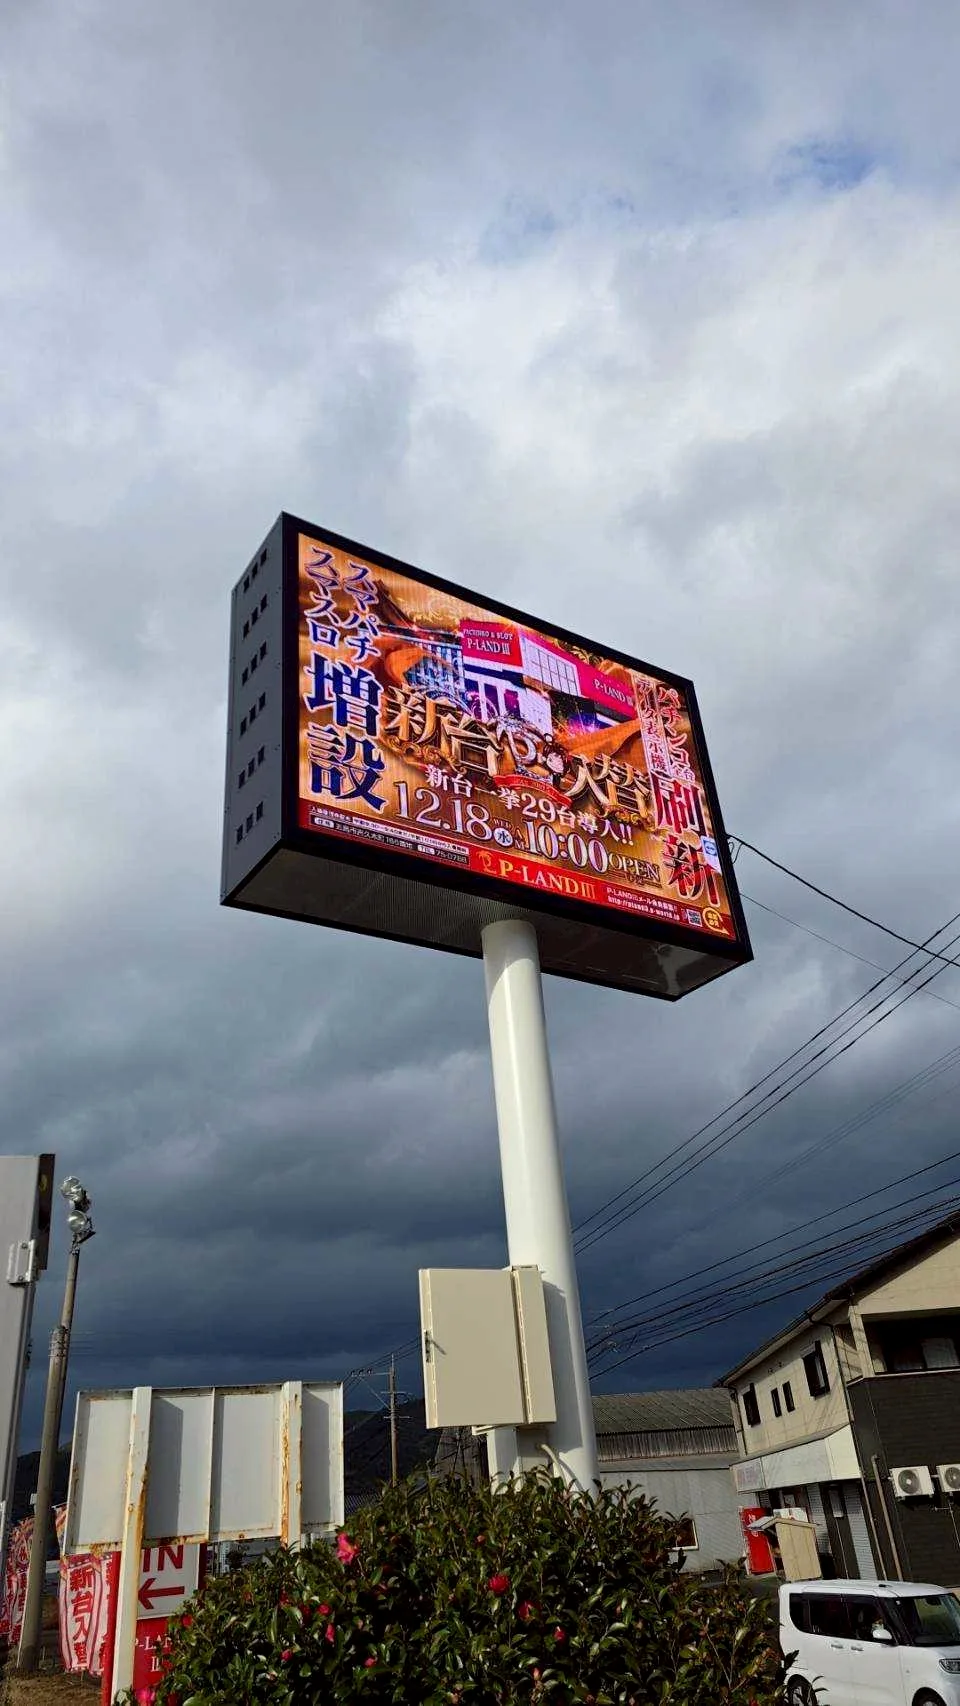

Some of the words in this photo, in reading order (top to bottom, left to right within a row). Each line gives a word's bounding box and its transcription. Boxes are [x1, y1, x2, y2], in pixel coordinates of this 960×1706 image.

[304, 546, 341, 648] スマスロ
[343, 561, 380, 662] スマパチ
[467, 638, 501, 654] P-LAND
[304, 651, 389, 813] 増設
[594, 678, 627, 702] P-LAND
[384, 686, 500, 778] 新台
[563, 752, 651, 818] 入替
[393, 780, 493, 841] 12.18
[523, 821, 609, 874] 10:00
[609, 853, 660, 880] OPEN
[650, 768, 721, 908] 刷新
[143, 1544, 184, 1572] IN
[70, 1565, 93, 1665] 新台入替
